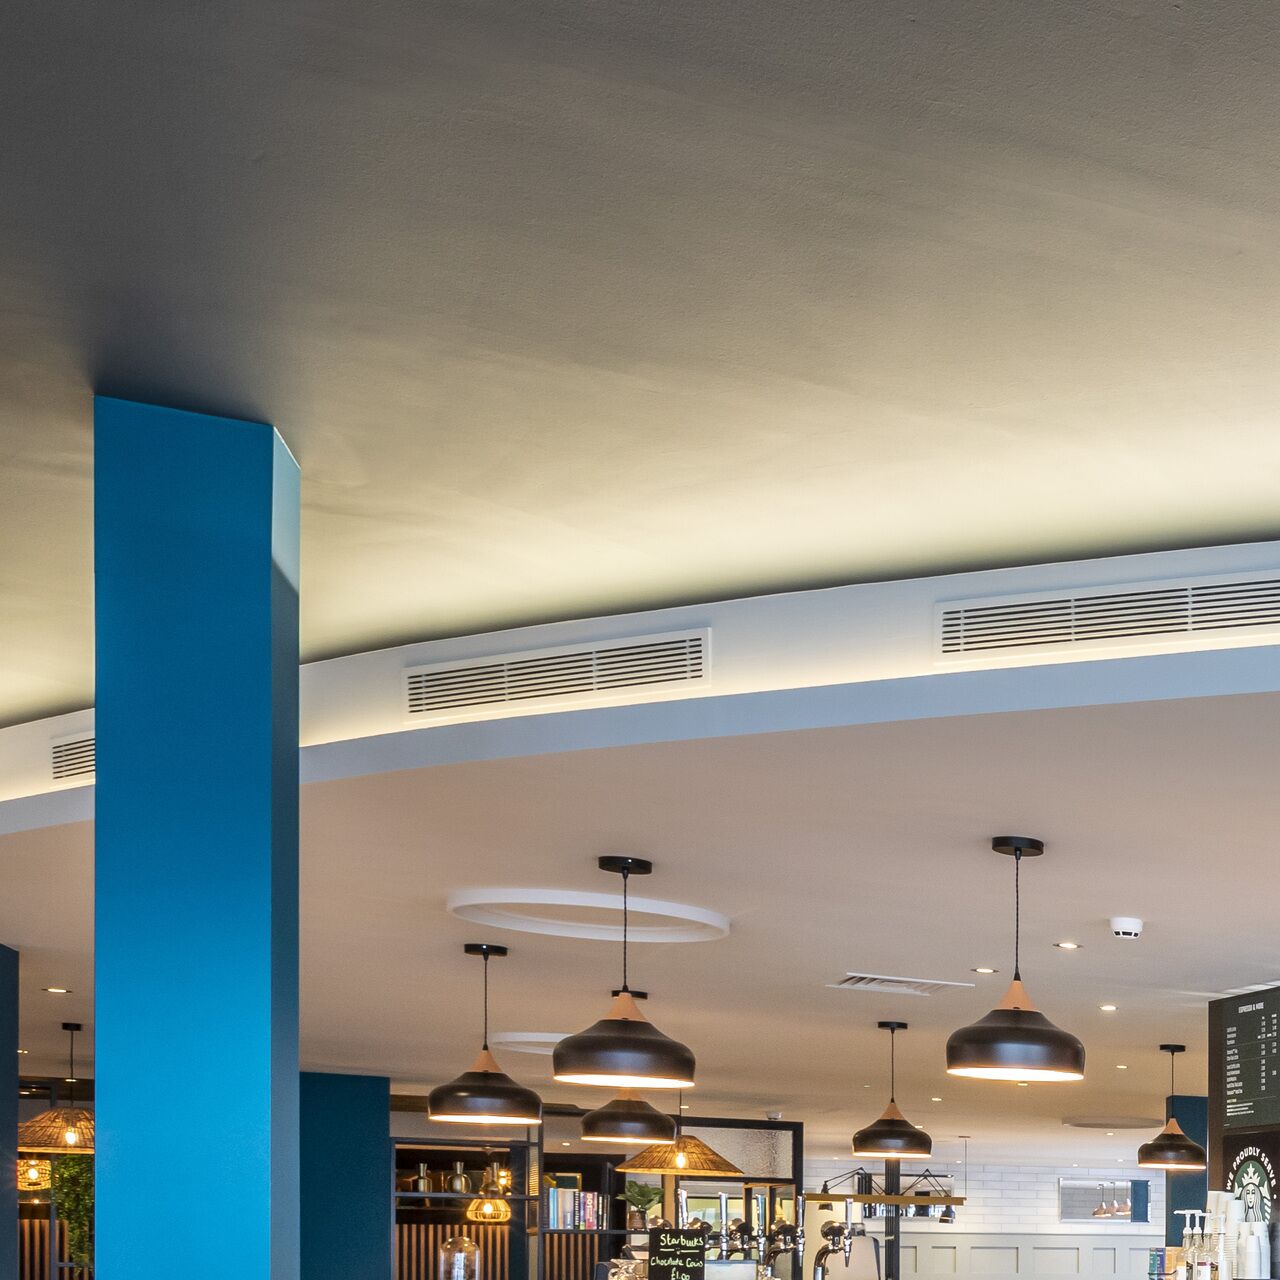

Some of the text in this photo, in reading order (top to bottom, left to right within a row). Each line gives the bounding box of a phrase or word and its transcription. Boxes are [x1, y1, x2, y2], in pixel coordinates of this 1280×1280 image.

[1226, 1146, 1277, 1190] WE PROUDLY SERVE
[660, 1233, 704, 1246] Starbucks
